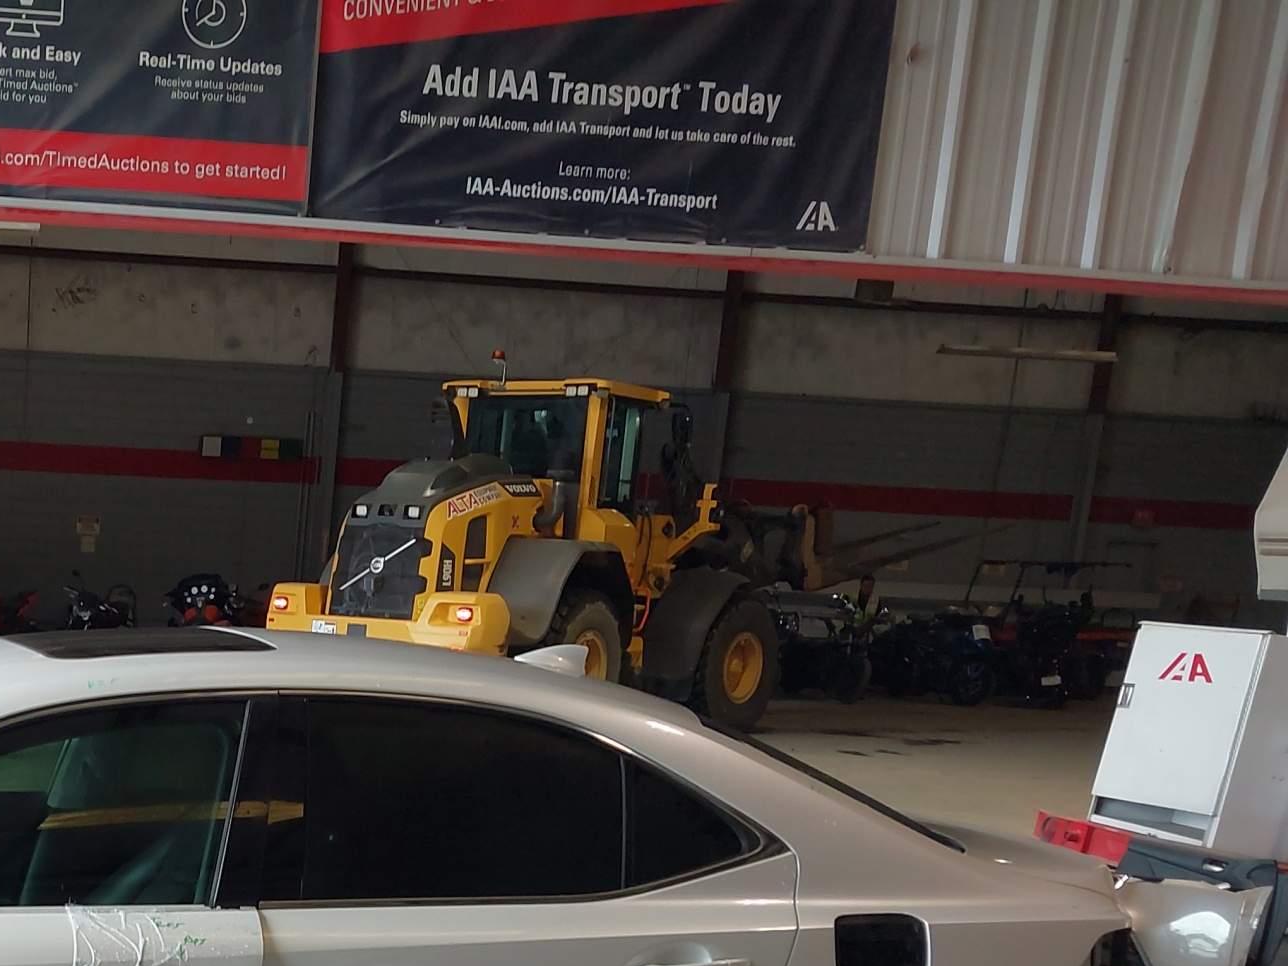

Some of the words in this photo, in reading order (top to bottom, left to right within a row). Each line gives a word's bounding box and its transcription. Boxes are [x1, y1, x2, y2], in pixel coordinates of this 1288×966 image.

[344, 0, 460, 20] CONVENIE
[12, 45, 41, 60] and
[45, 46, 81, 66] Easy
[139, 51, 215, 71] Real-Time
[220, 56, 282, 76] Updates
[15, 69, 36, 79] max
[39, 68, 58, 80] bid,
[154, 75, 192, 88] Receive
[195, 79, 223, 90] status
[226, 81, 264, 93] updates
[12, 90, 26, 102] for
[28, 94, 47, 105] you
[171, 89, 199, 100] about
[202, 91, 223, 103] your
[226, 92, 246, 104] bids
[422, 64, 479, 98] Add
[488, 68, 539, 102] IAA
[699, 81, 782, 123] Today
[399, 110, 437, 128] Simply
[439, 116, 461, 129] pay
[462, 117, 476, 128] on
[532, 119, 553, 133] add
[556, 120, 577, 133] IAA
[579, 121, 630, 139] Transport
[633, 126, 652, 139] and
[655, 126, 668, 140] let
[671, 129, 684, 141] us
[686, 129, 710, 142] take
[713, 132, 738, 144] care
[740, 131, 751, 145] of
[752, 132, 768, 146] the
[771, 135, 796, 147] rest.
[174, 160, 190, 174] to
[195, 163, 220, 179] get
[225, 164, 286, 181] started!
[559, 161, 593, 179] Learn
[596, 166, 631, 181] more:
[466, 176, 718, 212] IAA-Auctions.com/IAA-Transport
[504, 484, 536, 493] VOLVO
[447, 493, 479, 518] ALTA
